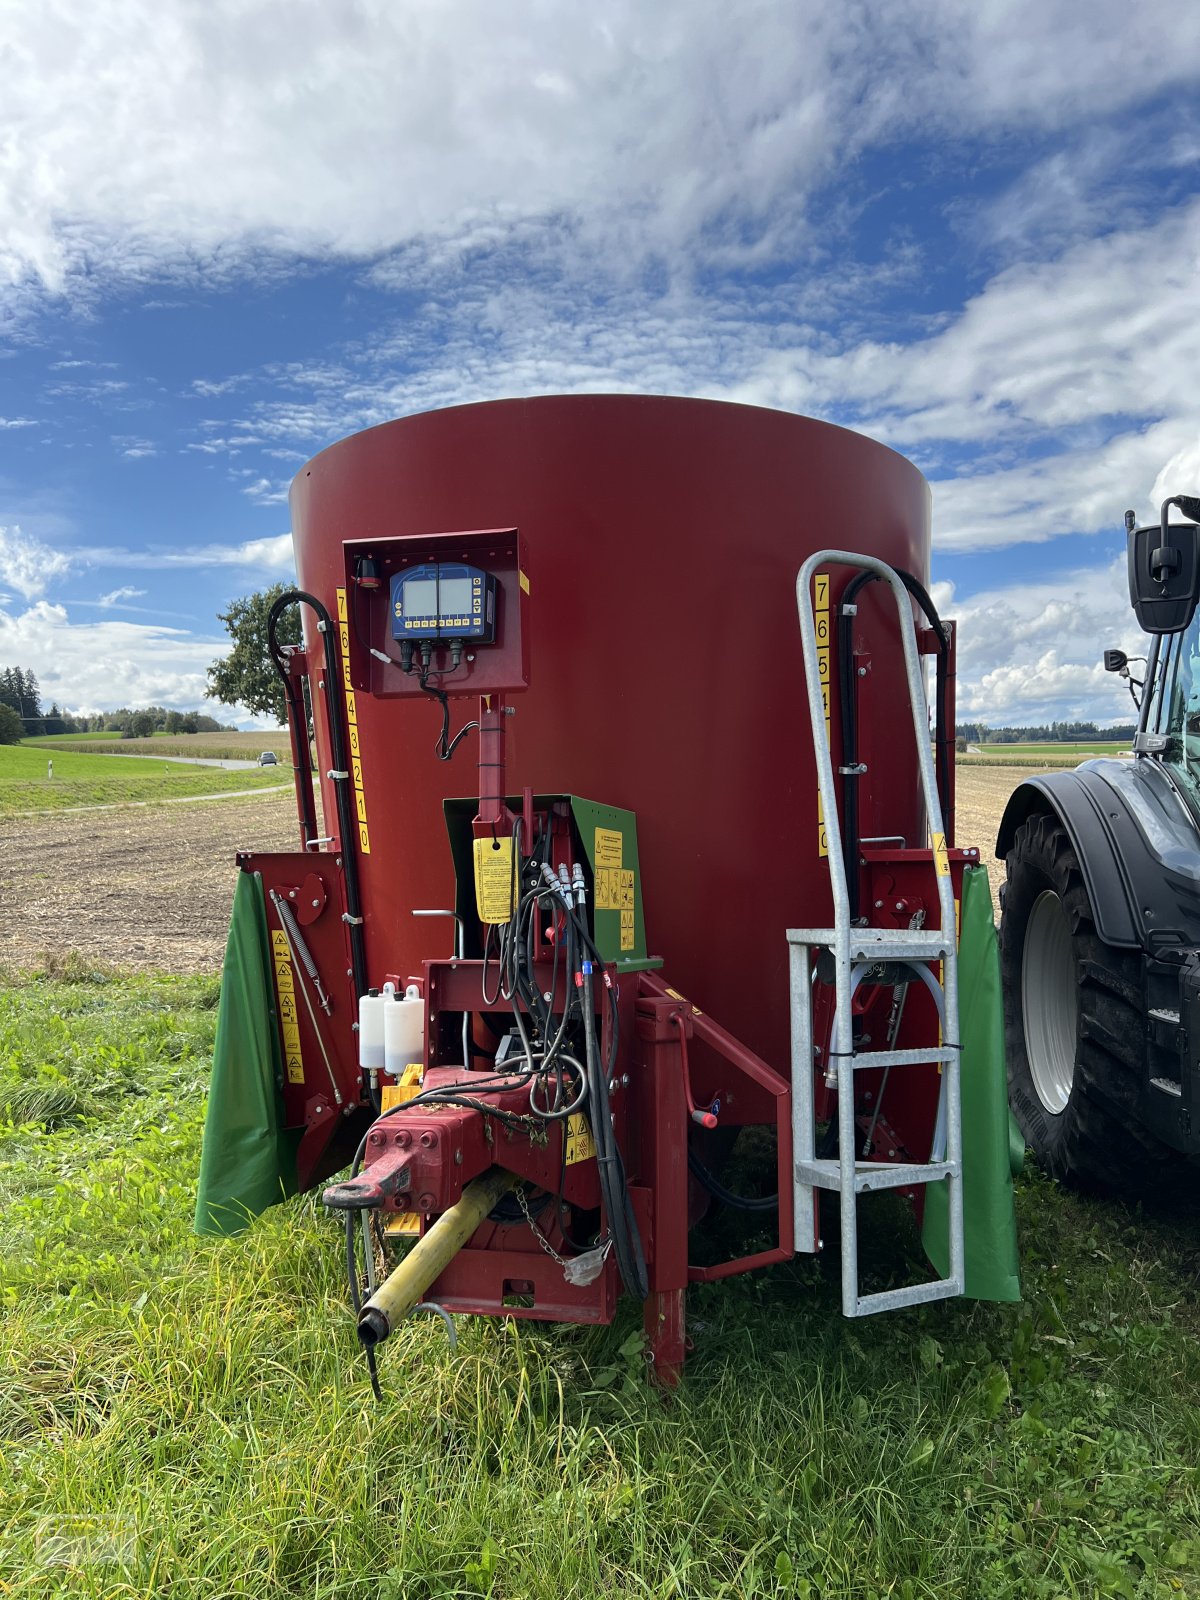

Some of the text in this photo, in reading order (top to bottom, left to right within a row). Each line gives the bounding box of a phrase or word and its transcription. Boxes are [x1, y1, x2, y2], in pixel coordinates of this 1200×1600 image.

[817, 582, 827, 601] 7
[338, 596, 345, 614] 7
[817, 619, 827, 638] 6
[342, 631, 349, 648] 6
[345, 665, 351, 682] 5
[818, 655, 828, 675] 5
[348, 699, 355, 716] 4
[351, 732, 358, 749] 3
[354, 765, 361, 782] 2
[358, 799, 364, 815] 1
[361, 830, 368, 846] 0
